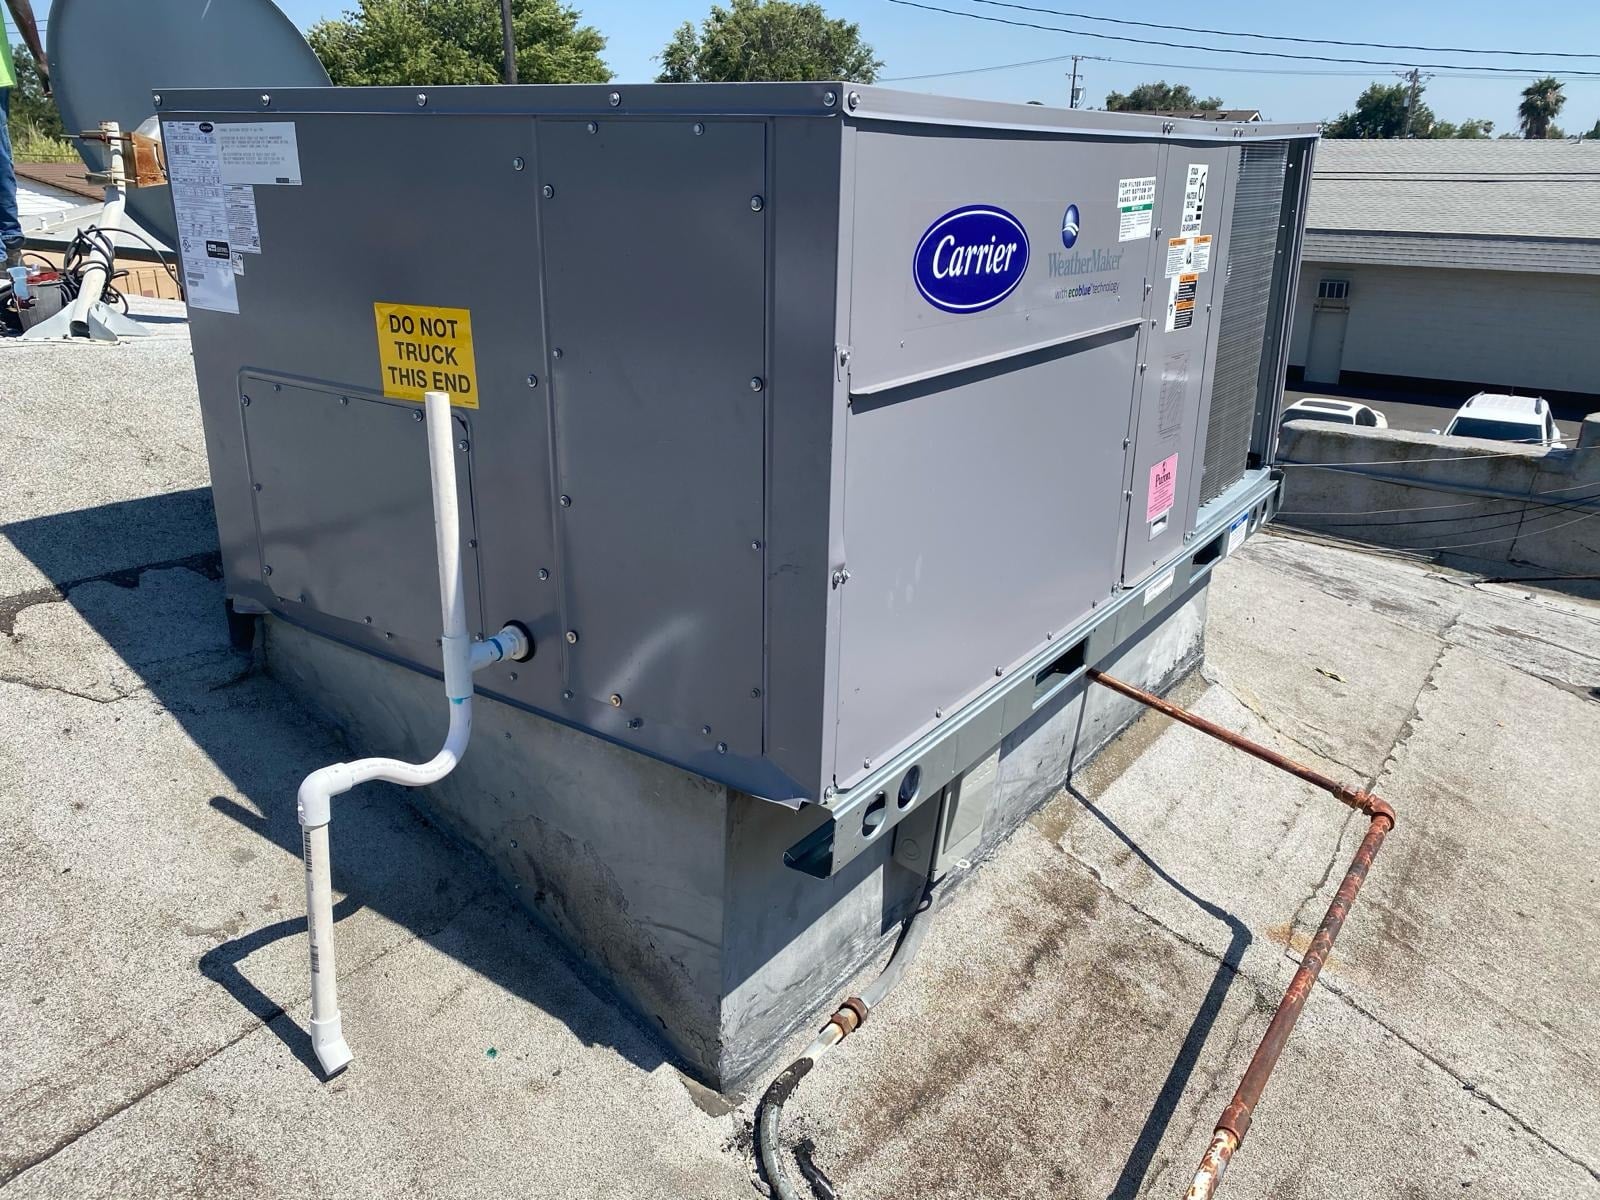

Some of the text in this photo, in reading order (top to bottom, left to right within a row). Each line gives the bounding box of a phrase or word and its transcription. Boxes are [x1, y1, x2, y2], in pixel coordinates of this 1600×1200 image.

[1198, 171, 1206, 203] 6
[932, 234, 1018, 279] Carrier
[1047, 249, 1124, 279] WeatherMaker
[1055, 287, 1067, 299] with
[1092, 281, 1121, 295] technology
[389, 314, 458, 339] DO NOT
[394, 340, 459, 366] TRUCK
[387, 366, 471, 394] THIS END
[1155, 471, 1171, 488] Puron
